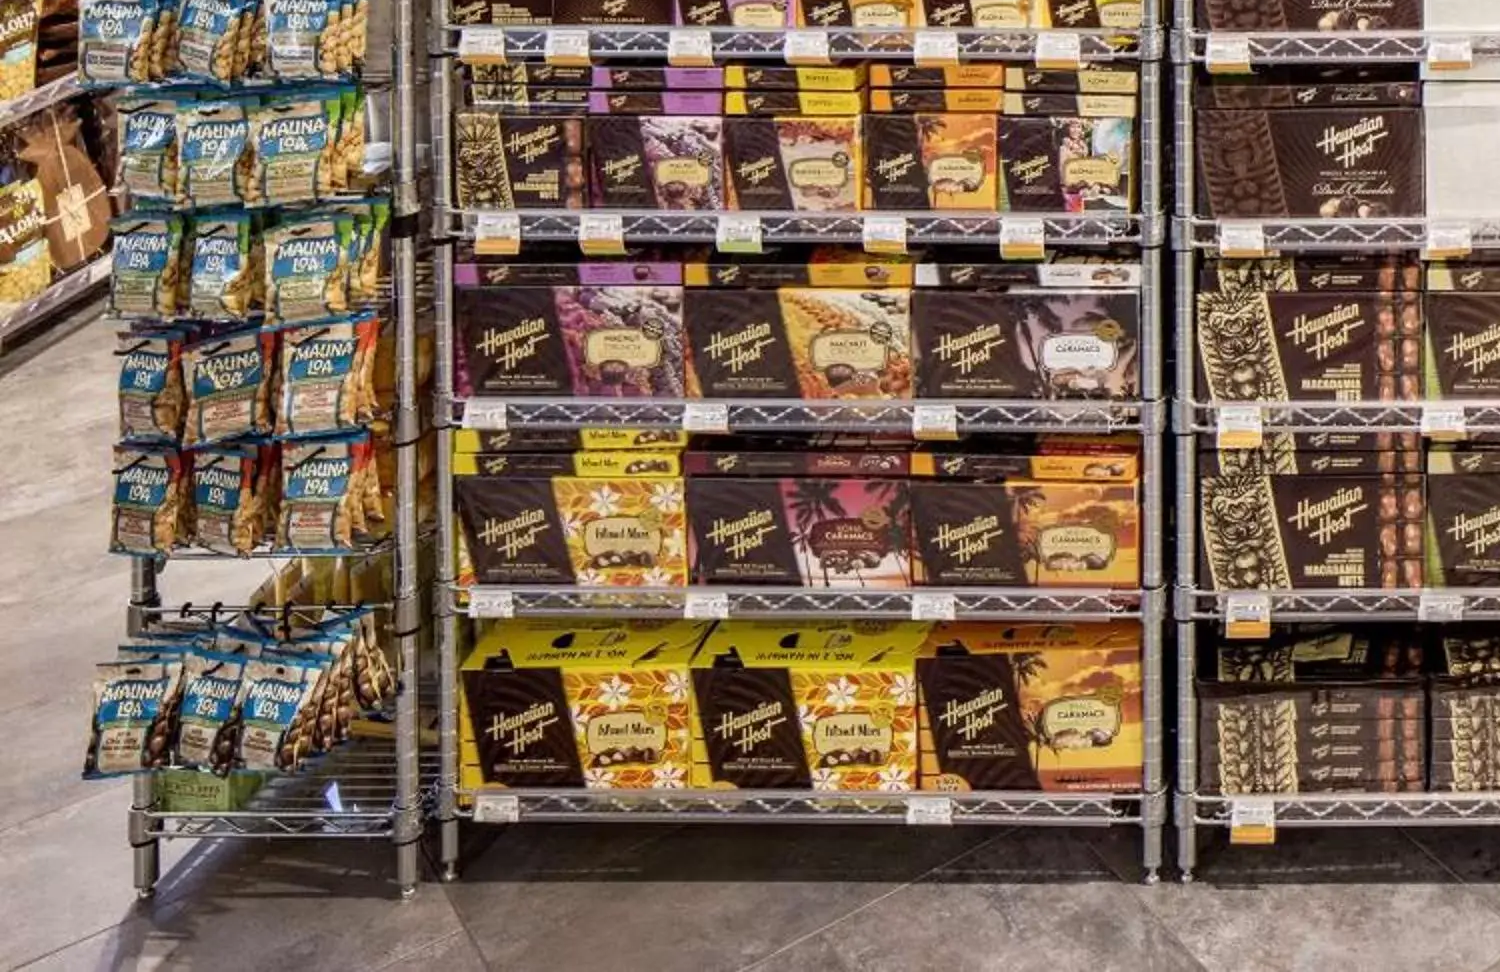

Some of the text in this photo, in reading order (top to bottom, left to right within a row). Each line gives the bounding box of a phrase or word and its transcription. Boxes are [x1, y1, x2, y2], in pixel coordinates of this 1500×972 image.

[88, 4, 143, 20] MAUNA
[274, 0, 328, 14] MAUNA
[188, 123, 246, 139] MAUNA
[263, 119, 325, 137] MAUNA
[279, 136, 309, 152] LOA
[505, 124, 557, 154] Hawaiian
[1316, 115, 1384, 154] Hawaiian
[518, 136, 559, 164] Host
[1336, 131, 1388, 168] Host
[278, 239, 338, 259] MAUNA
[291, 257, 317, 273] LOA
[476, 317, 545, 356] Hawaiian
[703, 322, 770, 359] Hawaiian
[1285, 303, 1360, 345] Hawaiian
[1306, 320, 1365, 361] Host
[295, 342, 354, 360] MAUNA
[495, 334, 551, 370] Host
[722, 337, 776, 373] Host
[932, 323, 1000, 360] Hawaiian
[952, 339, 1006, 375] Host
[198, 353, 260, 377] MAUNA
[306, 359, 333, 374] LOA
[1301, 379, 1361, 389] MACADAMIA
[120, 468, 169, 484] MAUNA
[293, 460, 349, 477] MAUNA
[303, 478, 329, 494] LOA
[1288, 486, 1363, 531] Hawaiian
[1309, 504, 1369, 545] Host
[477, 508, 545, 545] Hawaiian
[497, 524, 550, 559] Host
[706, 509, 773, 545] Hawaiian
[725, 525, 777, 560] Host
[825, 532, 874, 541] CARAMACS
[931, 515, 998, 551] Hawaiian
[951, 530, 1003, 564] Host
[103, 682, 163, 700] MAUNA
[189, 681, 237, 699] MAUNA
[251, 682, 300, 701] MAUNA
[940, 688, 1003, 726] Hawaiian
[118, 698, 143, 718] LOA
[254, 698, 279, 718] LOA
[485, 701, 554, 741] Hawaiian
[714, 700, 782, 739] Hawaiian
[957, 703, 1008, 740] Host
[504, 717, 559, 755] Host
[733, 717, 787, 753] Host
